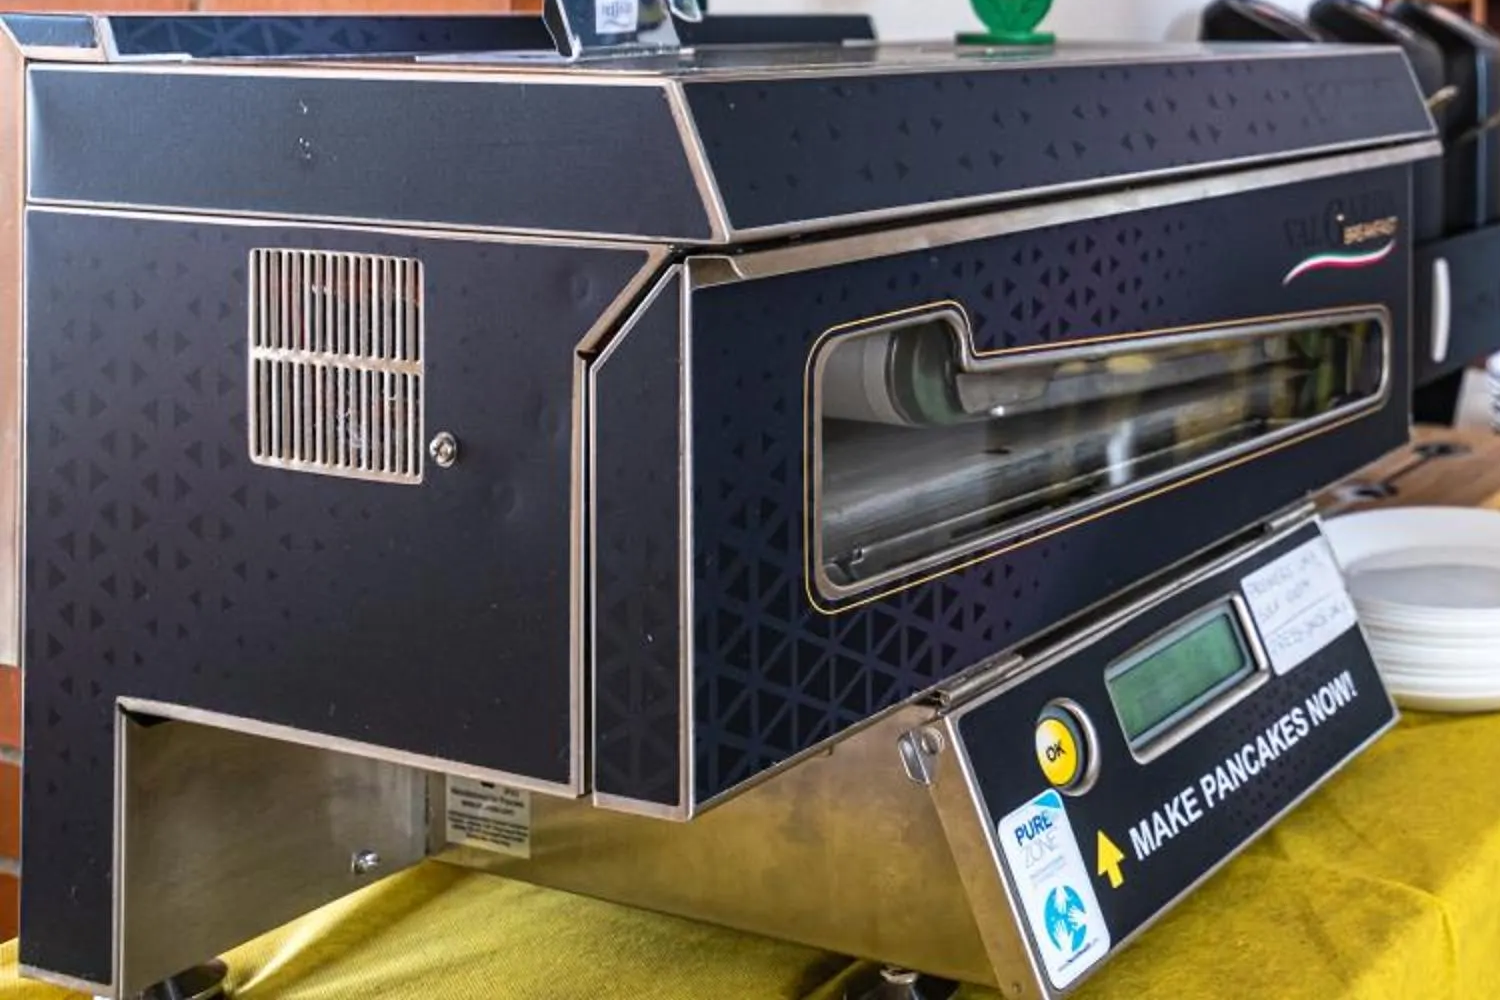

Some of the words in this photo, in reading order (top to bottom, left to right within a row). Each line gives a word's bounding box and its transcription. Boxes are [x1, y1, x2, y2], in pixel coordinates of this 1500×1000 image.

[1045, 739, 1066, 762] OK
[1128, 786, 1203, 861] MAKE
[1199, 707, 1310, 808] PANCAKES
[1305, 670, 1358, 726] NOW!
[1014, 811, 1053, 847] PURE
[1020, 829, 1058, 869] ZONE
